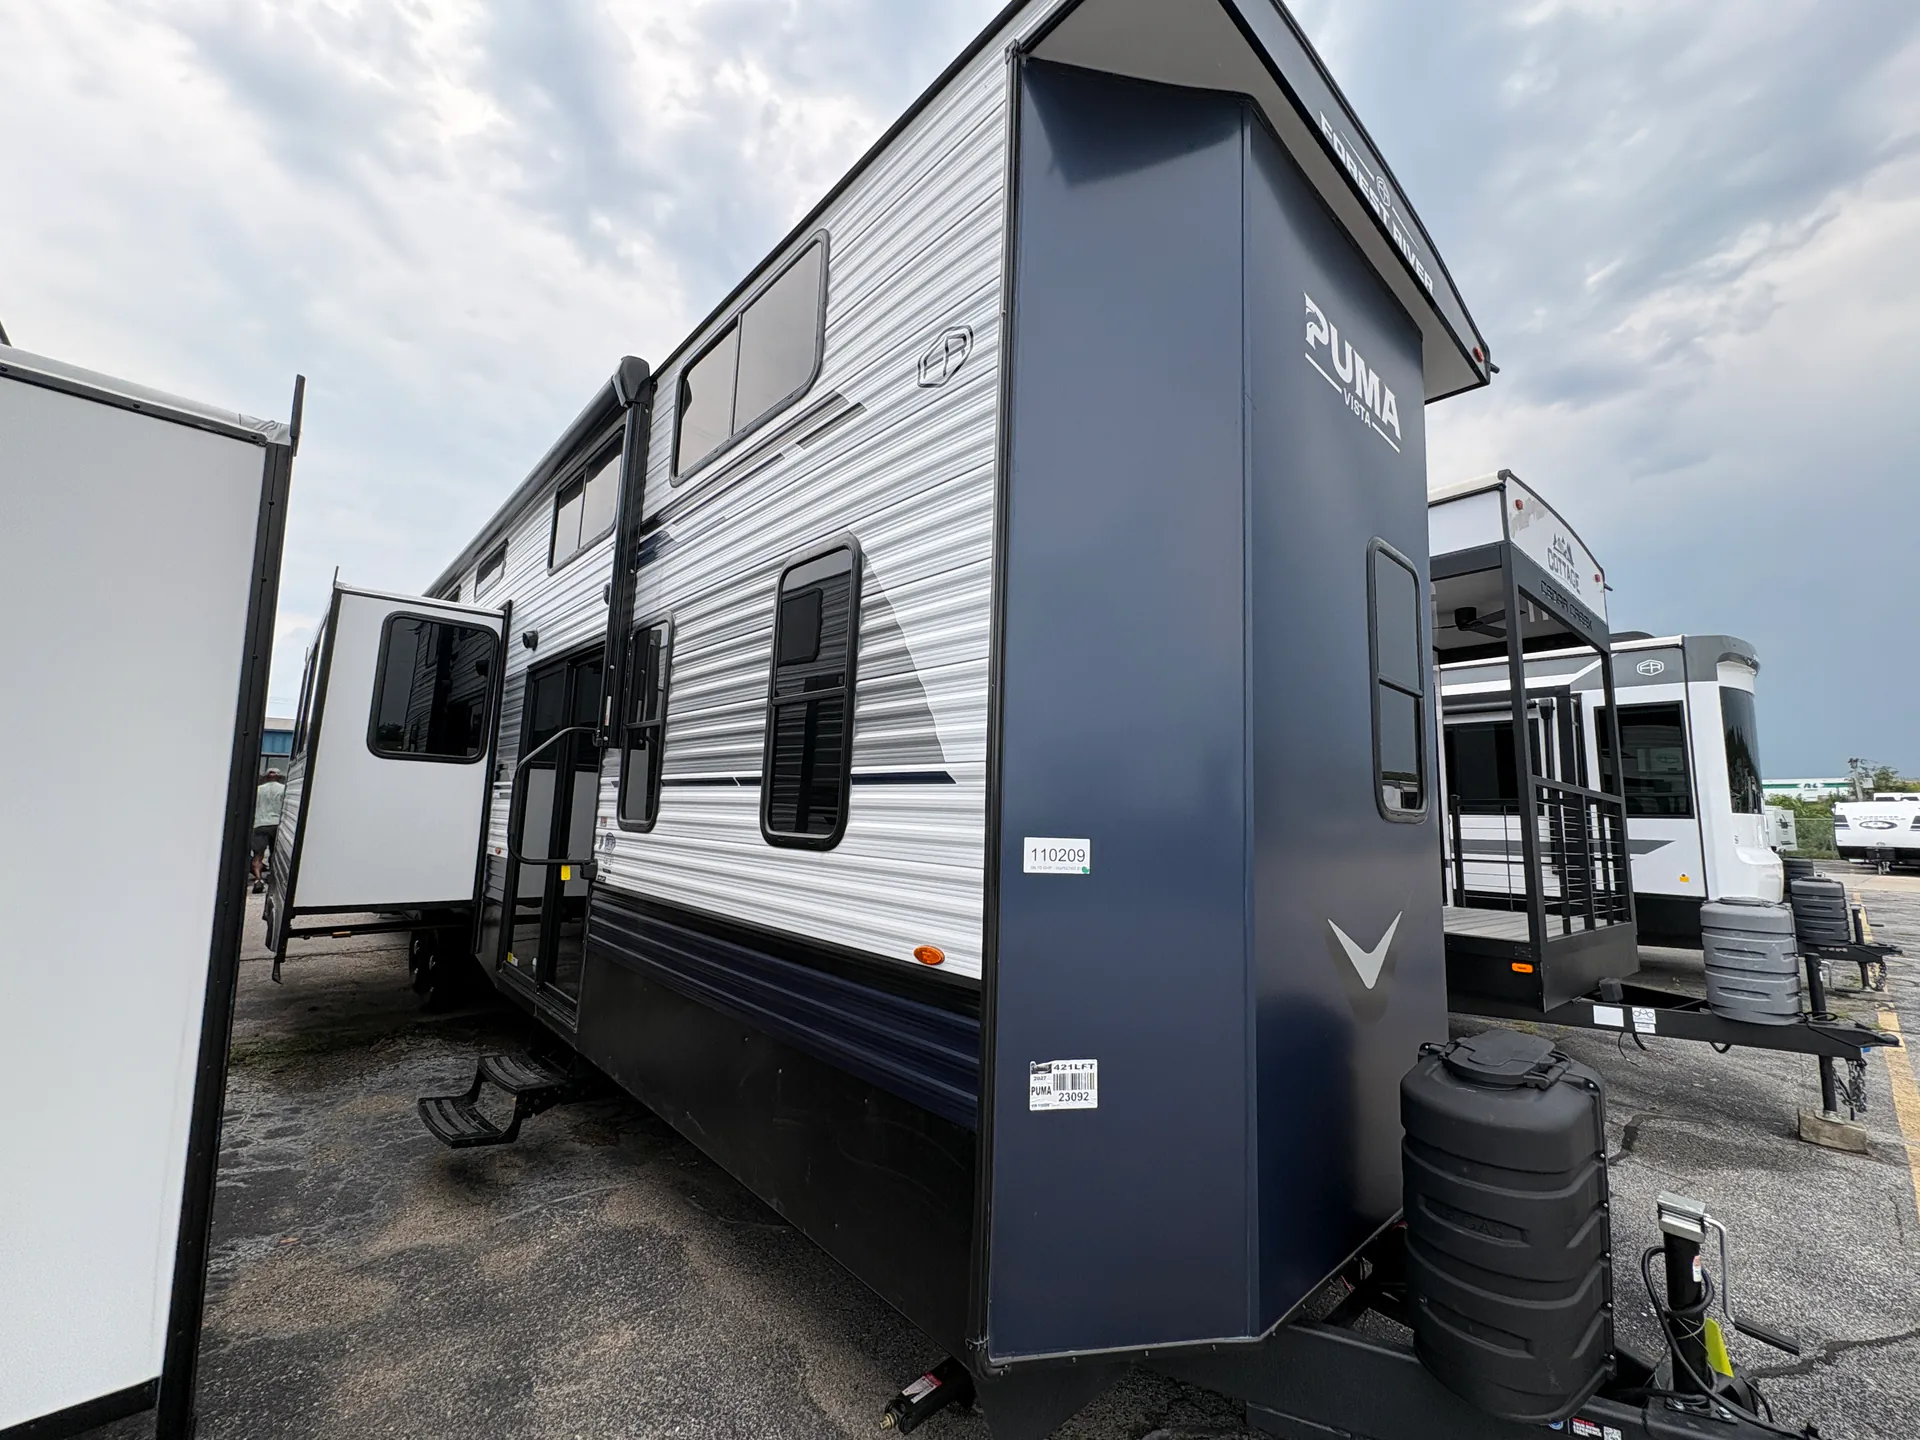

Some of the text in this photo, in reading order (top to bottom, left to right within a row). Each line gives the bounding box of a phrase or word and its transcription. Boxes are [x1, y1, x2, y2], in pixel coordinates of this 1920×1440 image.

[1320, 110, 1433, 293] FOREST RIVER
[1303, 290, 1401, 440] PUMA
[1343, 387, 1371, 428] VISTA
[1547, 547, 1581, 595] COTTAGE
[1540, 580, 1593, 632] CEDAR CREEK
[1031, 848, 1086, 862] 110209
[1053, 1063, 1095, 1071] 421LFT
[1031, 1086, 1052, 1096] PUMA
[1058, 1092, 1090, 1102] 23092
